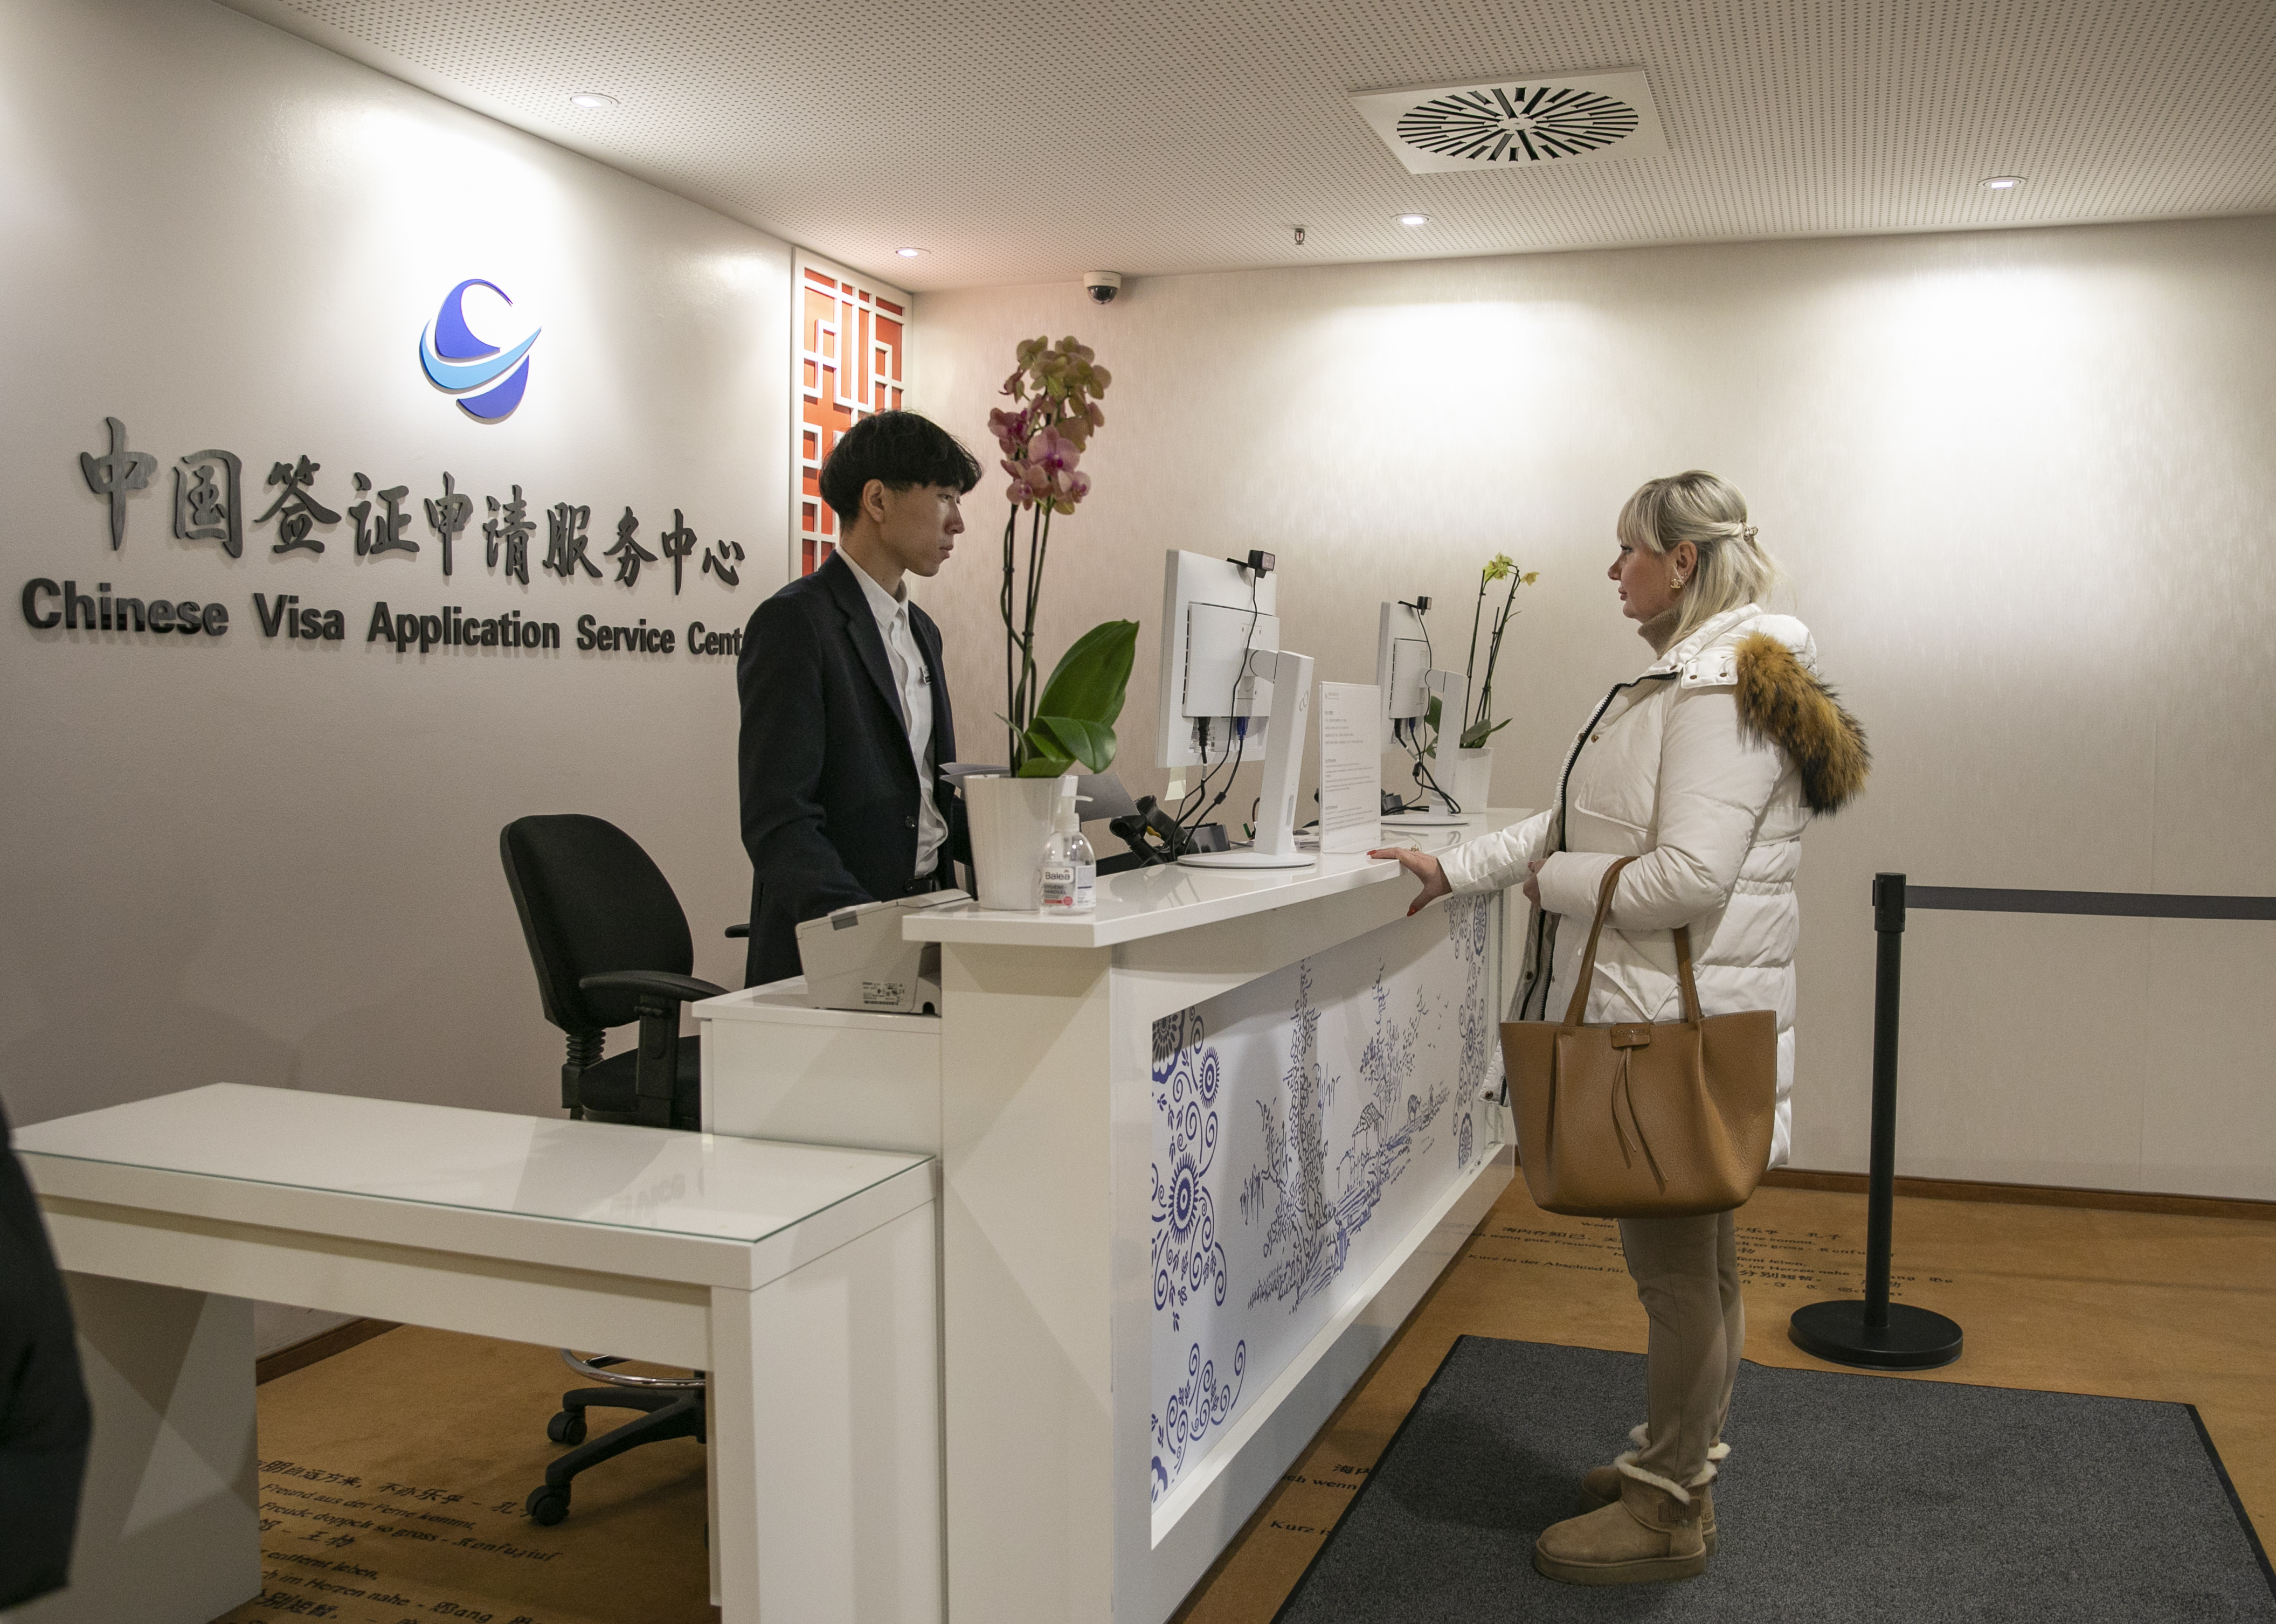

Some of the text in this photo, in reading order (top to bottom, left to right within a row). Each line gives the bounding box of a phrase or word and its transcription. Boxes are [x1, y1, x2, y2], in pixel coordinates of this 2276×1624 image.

[79, 417, 746, 595] 中国签证申请服务中心
[22, 578, 743, 656] Chinese Visa Application Service Cent
[1046, 871, 1070, 880] Balea
[1313, 1479, 1357, 1490] wenn
[260, 1483, 317, 1499] Freund
[313, 1494, 343, 1504] aus
[343, 1499, 373, 1508] der
[372, 1503, 417, 1518] Ferne
[259, 1502, 313, 1517] Freude
[312, 1512, 374, 1529] doppelt
[391, 1528, 439, 1542] gross
[1270, 1521, 1315, 1533] Kurz
[304, 1578, 366, 1597] Herzen
[366, 1592, 410, 1606] nahe
